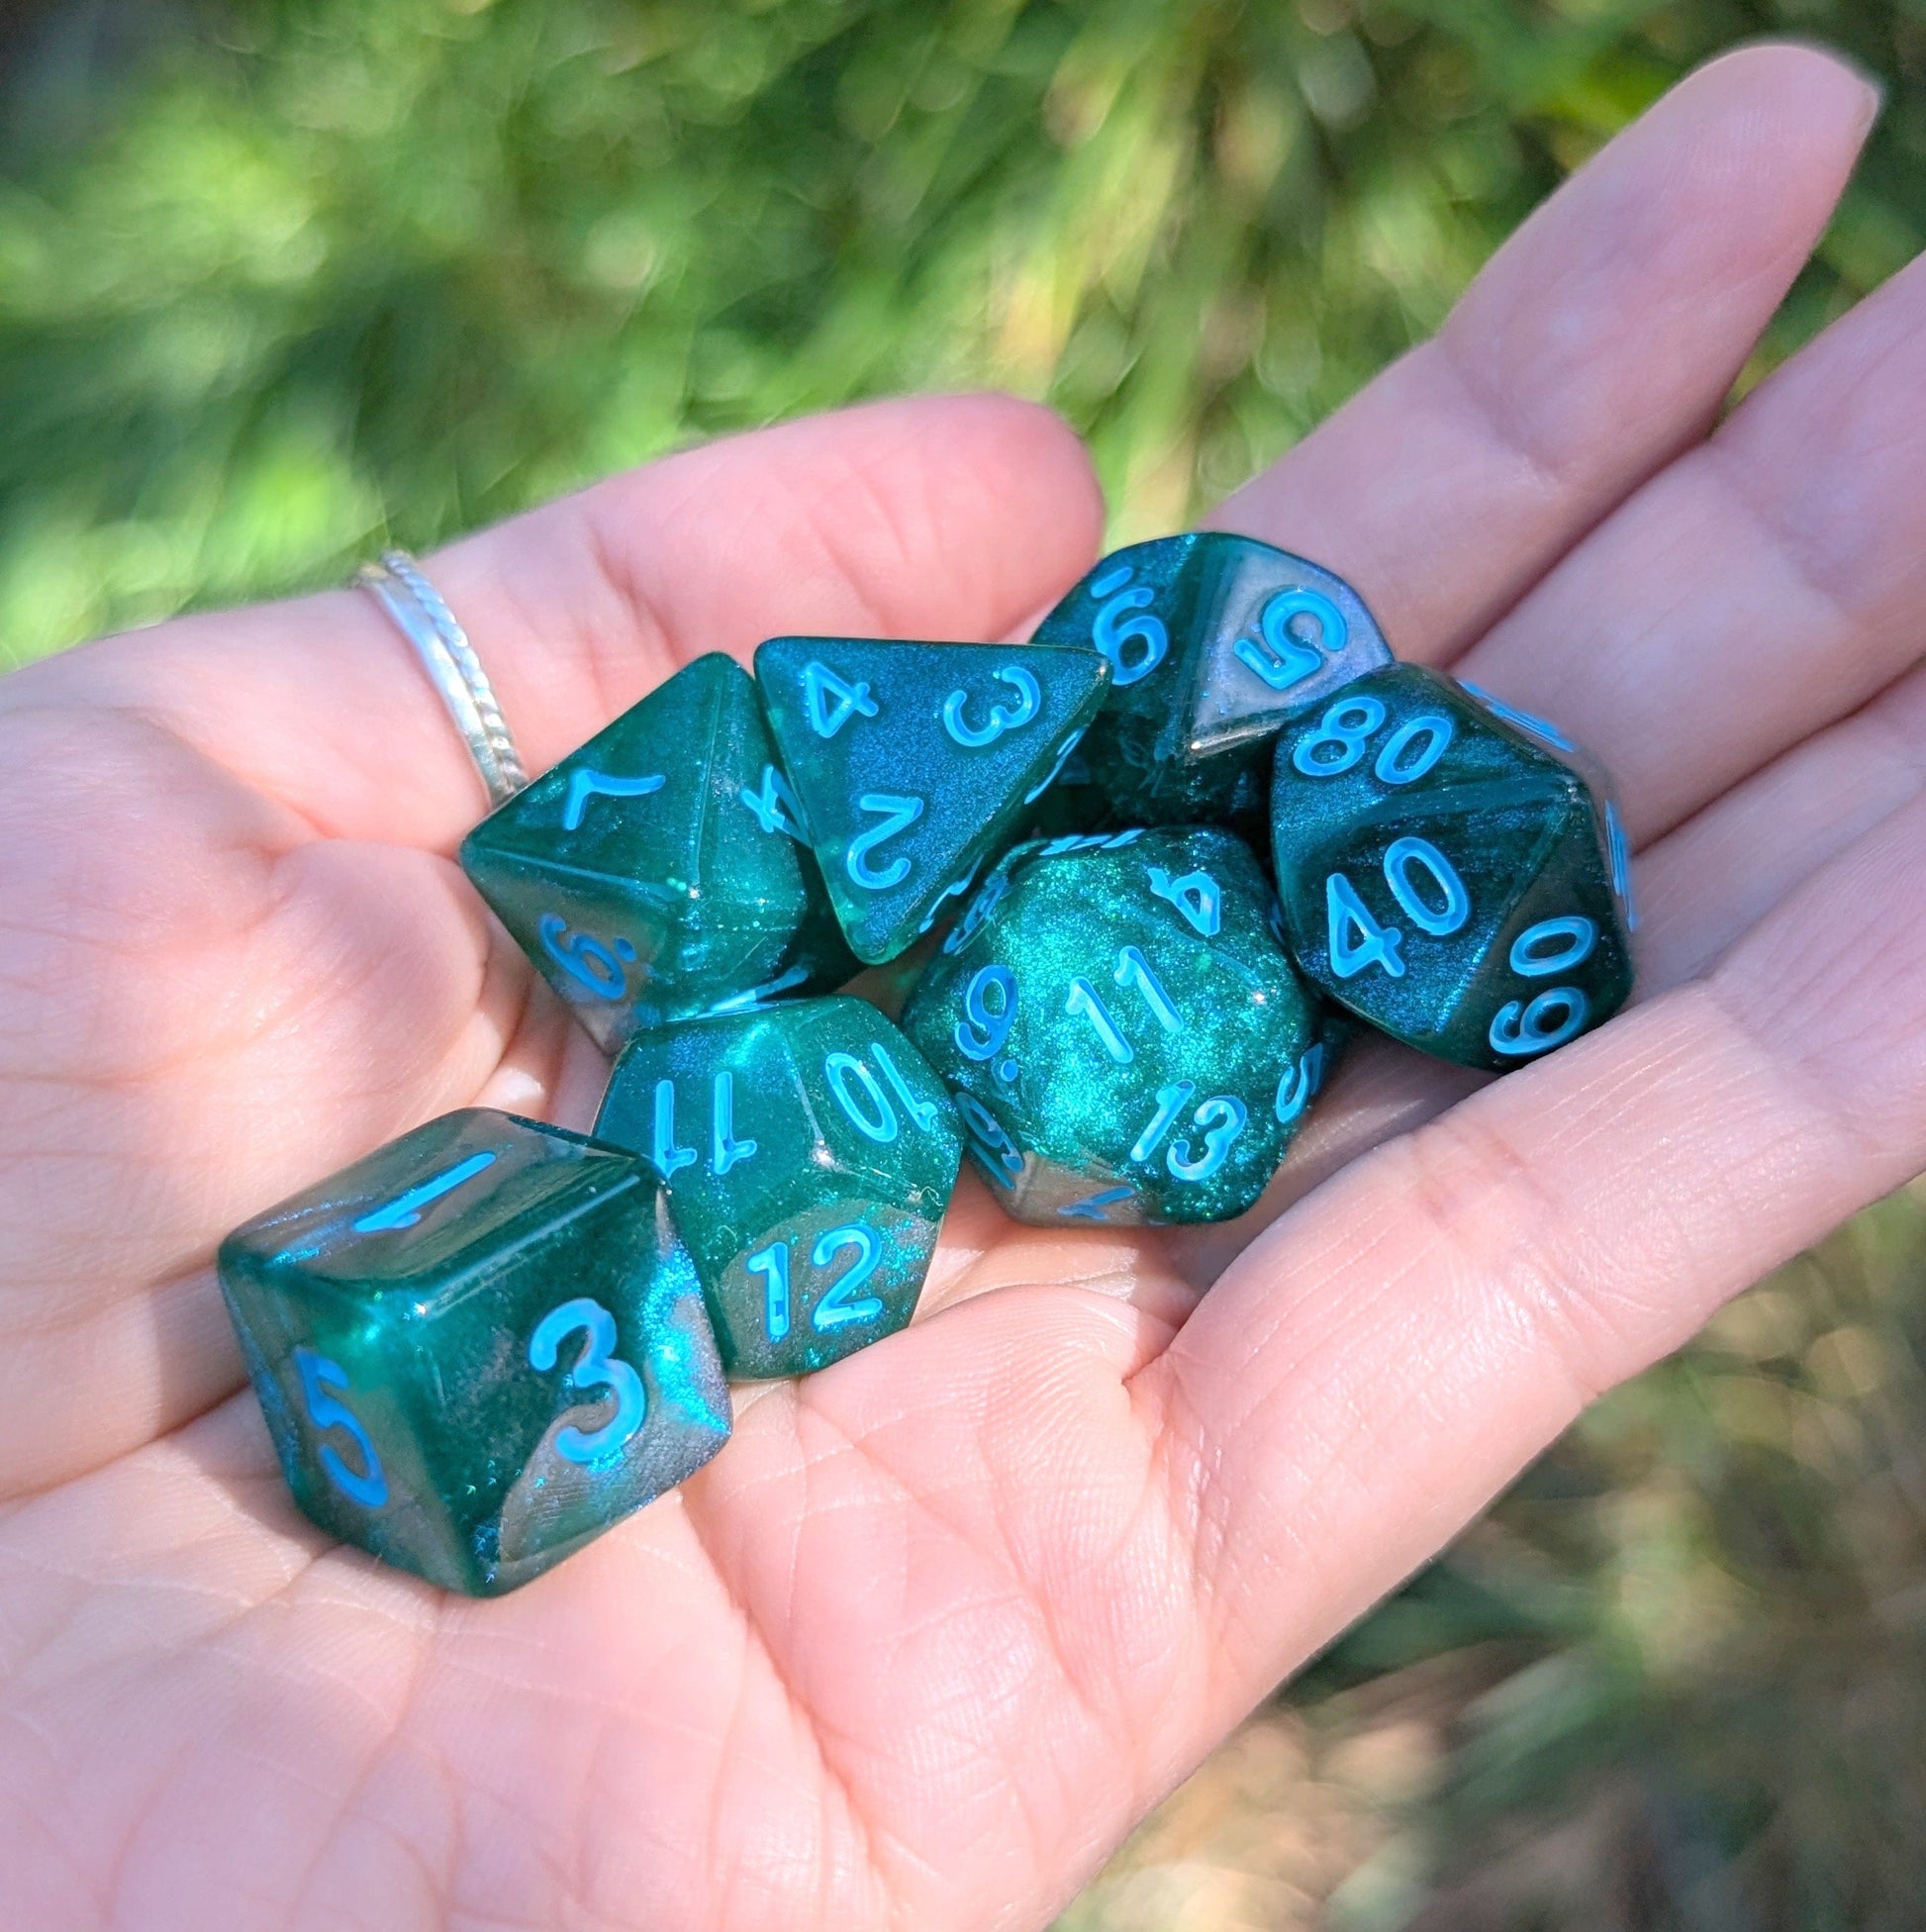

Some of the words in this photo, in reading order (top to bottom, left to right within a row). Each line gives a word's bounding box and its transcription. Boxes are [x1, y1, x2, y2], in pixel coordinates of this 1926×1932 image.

[1234, 588, 1349, 690] 5
[805, 661, 879, 738] 4
[942, 665, 1041, 747] 3
[1293, 697, 1453, 785] 80
[563, 769, 666, 830] 7
[846, 795, 924, 890] 2
[1146, 867, 1221, 936] 4
[1326, 836, 1471, 979] 40
[1065, 945, 1185, 1064] 11
[654, 1071, 757, 1176] 11
[824, 1042, 938, 1143] 10
[1129, 1080, 1248, 1182] 13
[353, 1152, 496, 1233] 1
[747, 1223, 883, 1344] 12
[296, 1344, 389, 1507] 5
[529, 1298, 646, 1464] 3
